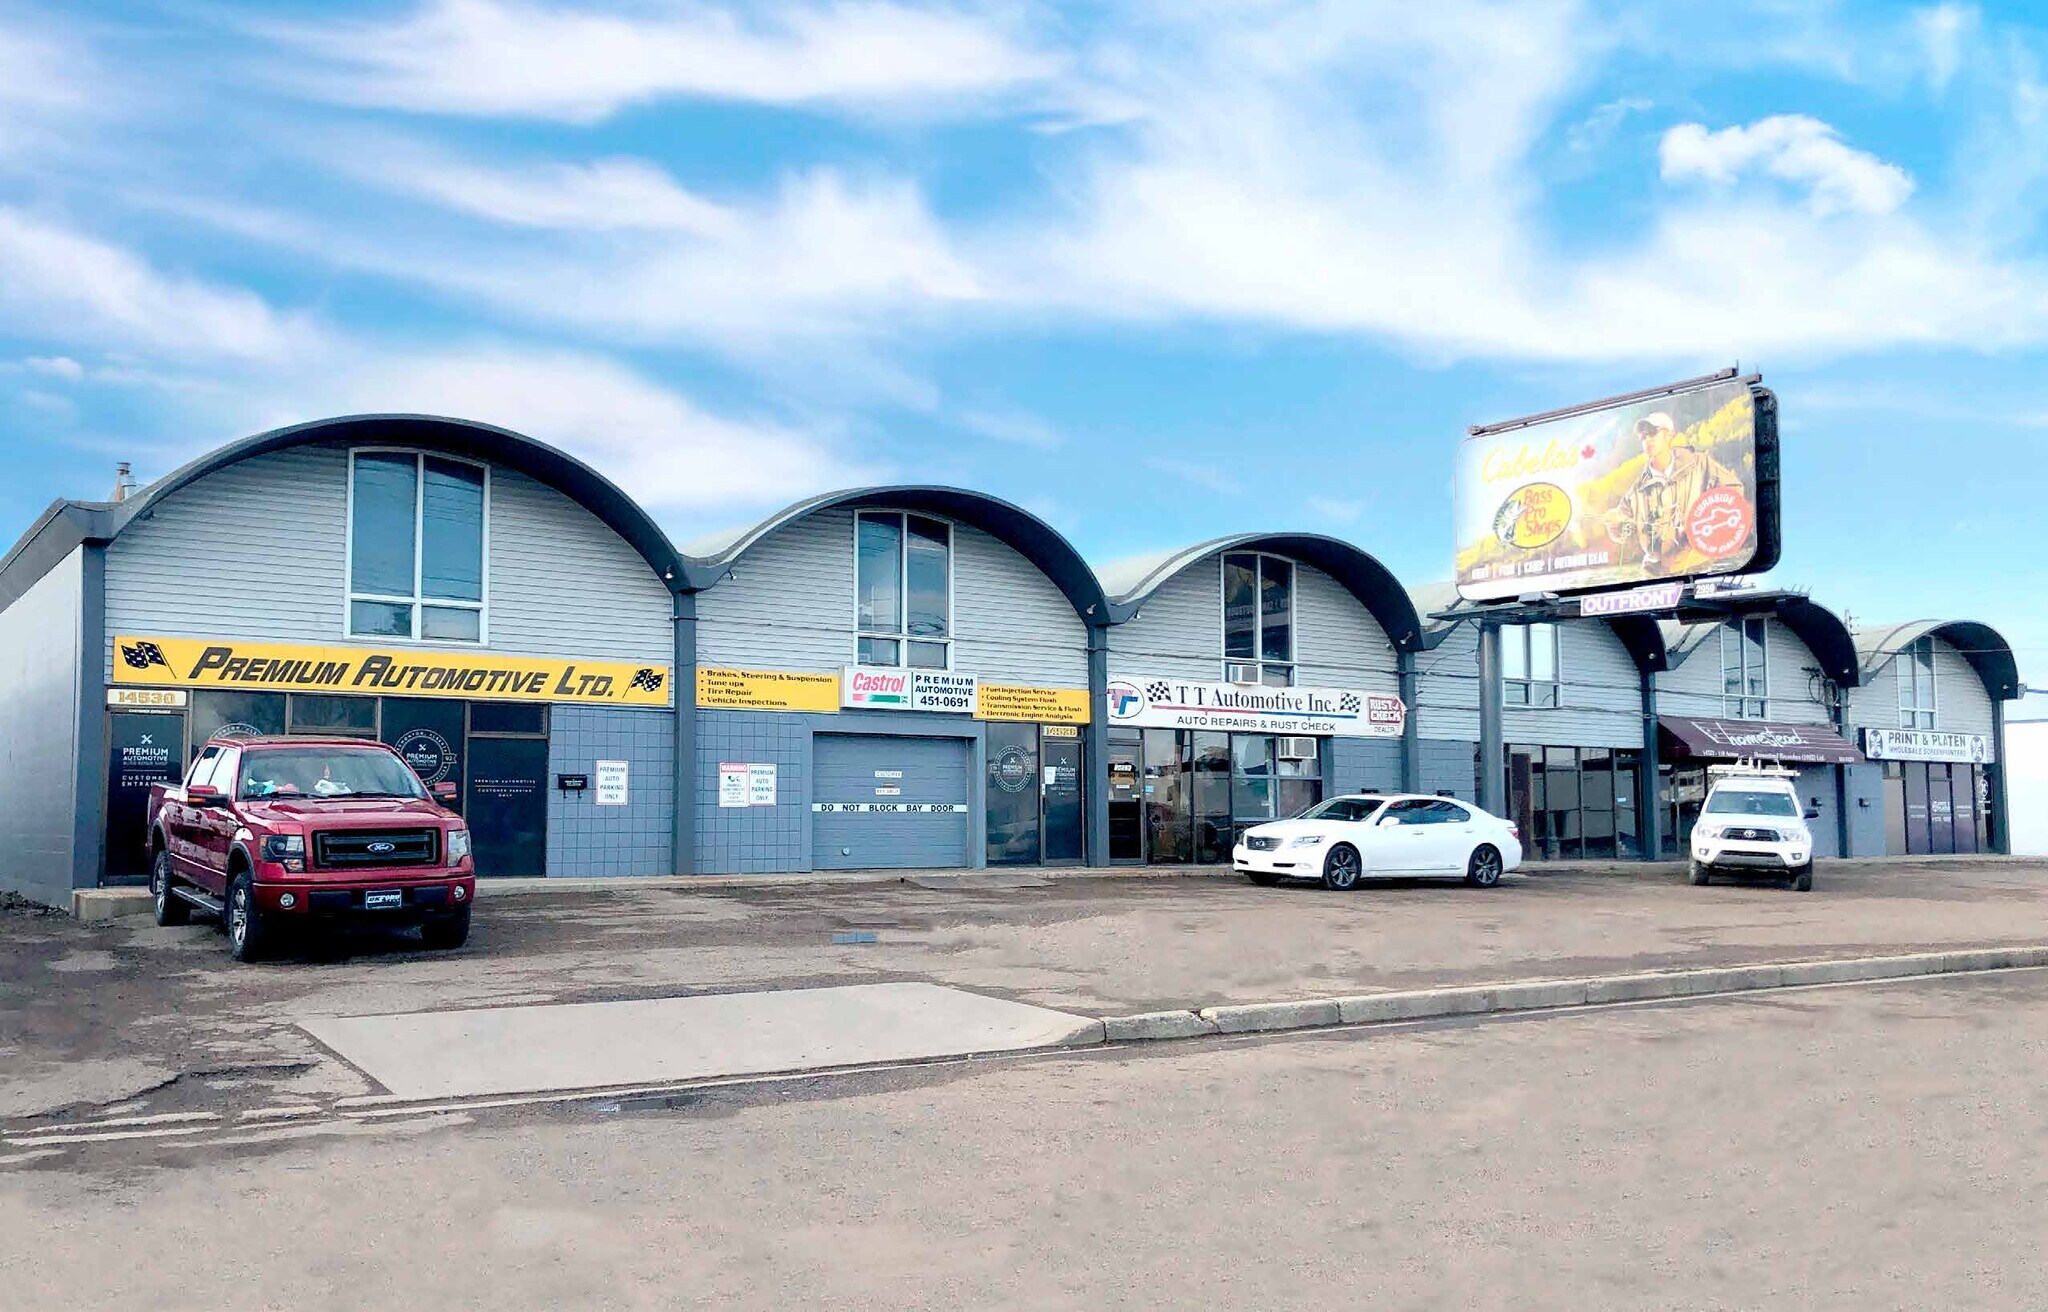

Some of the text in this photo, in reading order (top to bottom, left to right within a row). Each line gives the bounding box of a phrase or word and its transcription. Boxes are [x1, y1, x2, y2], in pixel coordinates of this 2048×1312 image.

[1524, 489, 1553, 507] Bass
[1524, 506, 1546, 520] Pro
[1524, 519, 1562, 537] Shops
[1583, 587, 1678, 613] OUTFRONT
[188, 646, 351, 685] PREMIUM
[352, 655, 550, 693] AUTOMOTIVE
[707, 670, 740, 679] Brakes,
[741, 671, 777, 681] Steering
[786, 675, 833, 684] Suspension
[852, 672, 907, 692] Castrol
[915, 675, 974, 686] PREMIUM
[725, 688, 752, 697] Repair
[915, 685, 974, 696] AUTOMOTIVE
[1001, 687, 1032, 695] Injection
[118, 692, 176, 704] 14530
[707, 696, 788, 707] Vehicle Inspections
[920, 696, 969, 707] 451-0691
[986, 694, 1012, 702] Cooling
[1211, 688, 1303, 711] Automotive
[1307, 692, 1336, 712] Inc.
[986, 702, 1032, 710] Transmission
[986, 710, 1073, 720] Electronic Engine Analysis
[1177, 716, 1336, 732] AUTO REPAIRS & RUST CHECK
[1888, 732, 1966, 747] PRINT & PLATEN
[123, 747, 168, 756] PREMIUM
[869, 804, 898, 812] BLOCK
[907, 804, 922, 812] BAY
[931, 804, 954, 812] DOOR
